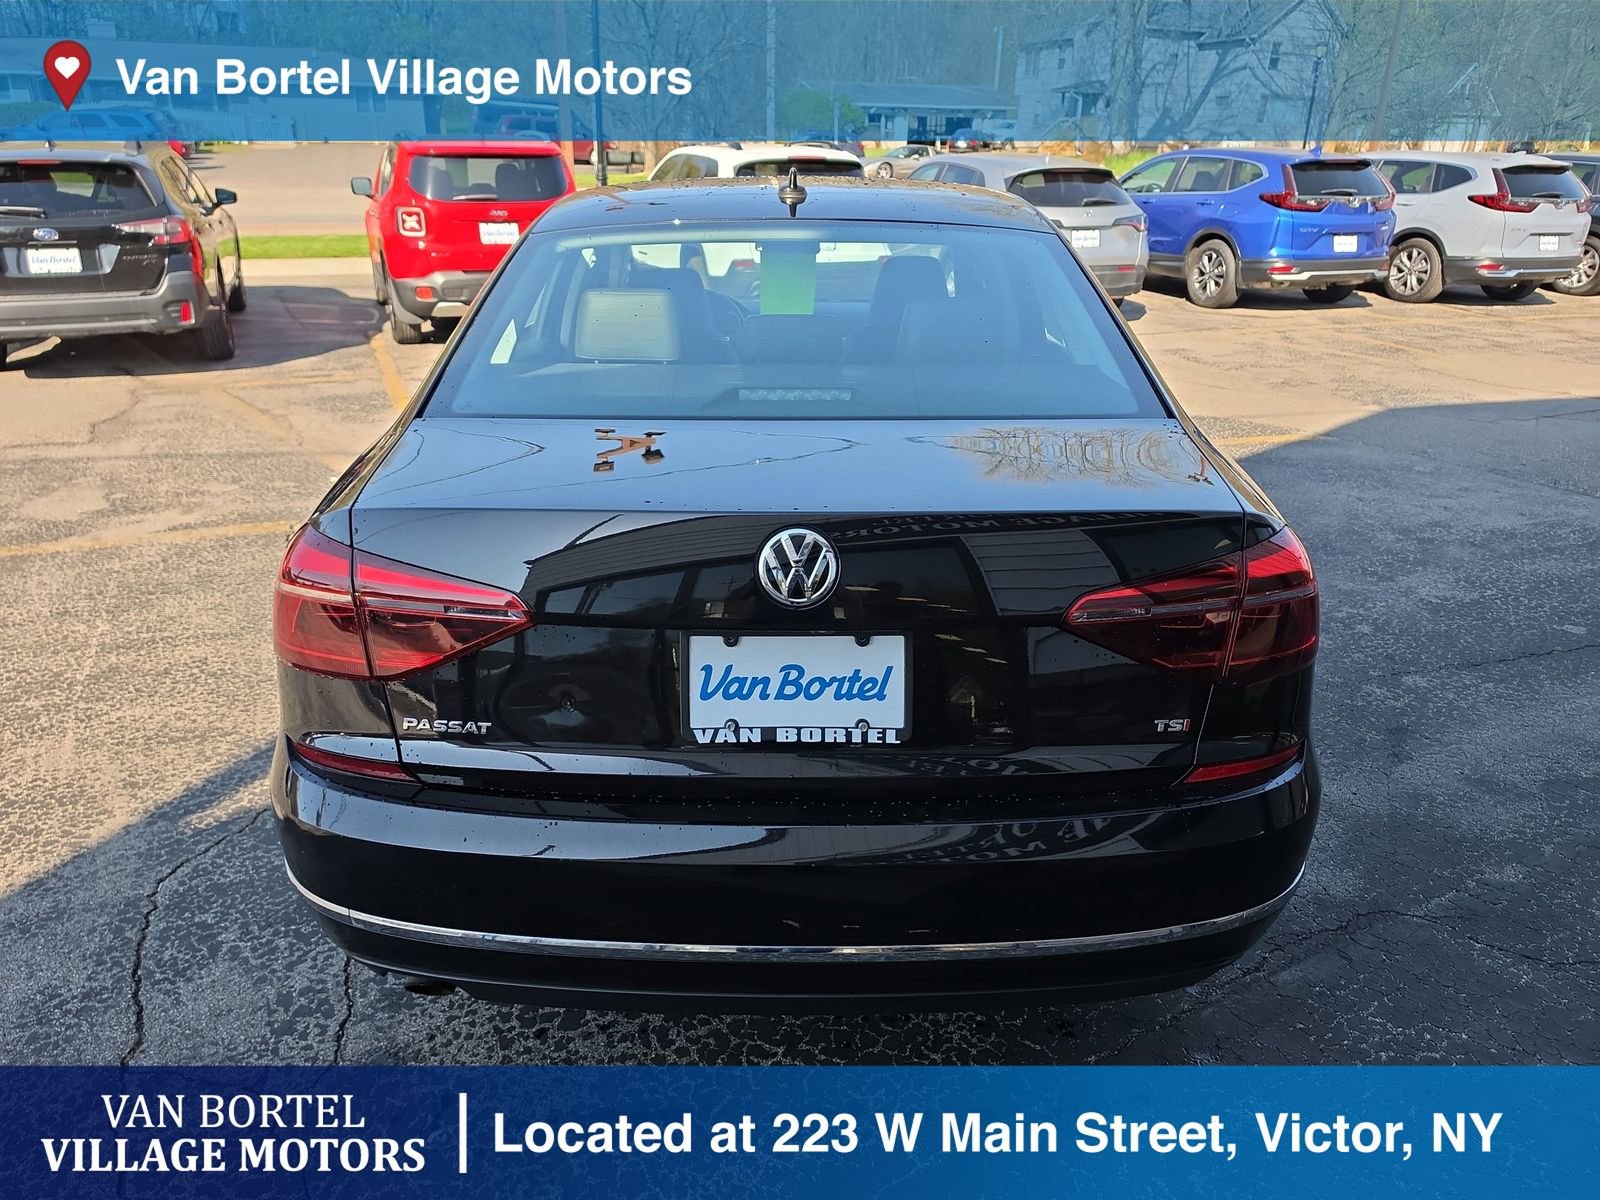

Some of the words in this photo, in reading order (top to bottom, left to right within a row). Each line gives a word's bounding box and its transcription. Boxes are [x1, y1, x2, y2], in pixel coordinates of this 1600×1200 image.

[699, 663, 771, 701] Van
[773, 663, 895, 702] Bortel
[402, 717, 492, 735] PASSAT
[1154, 718, 1191, 732] TSI
[693, 727, 763, 744] VAN
[776, 727, 901, 744] BORTEL
